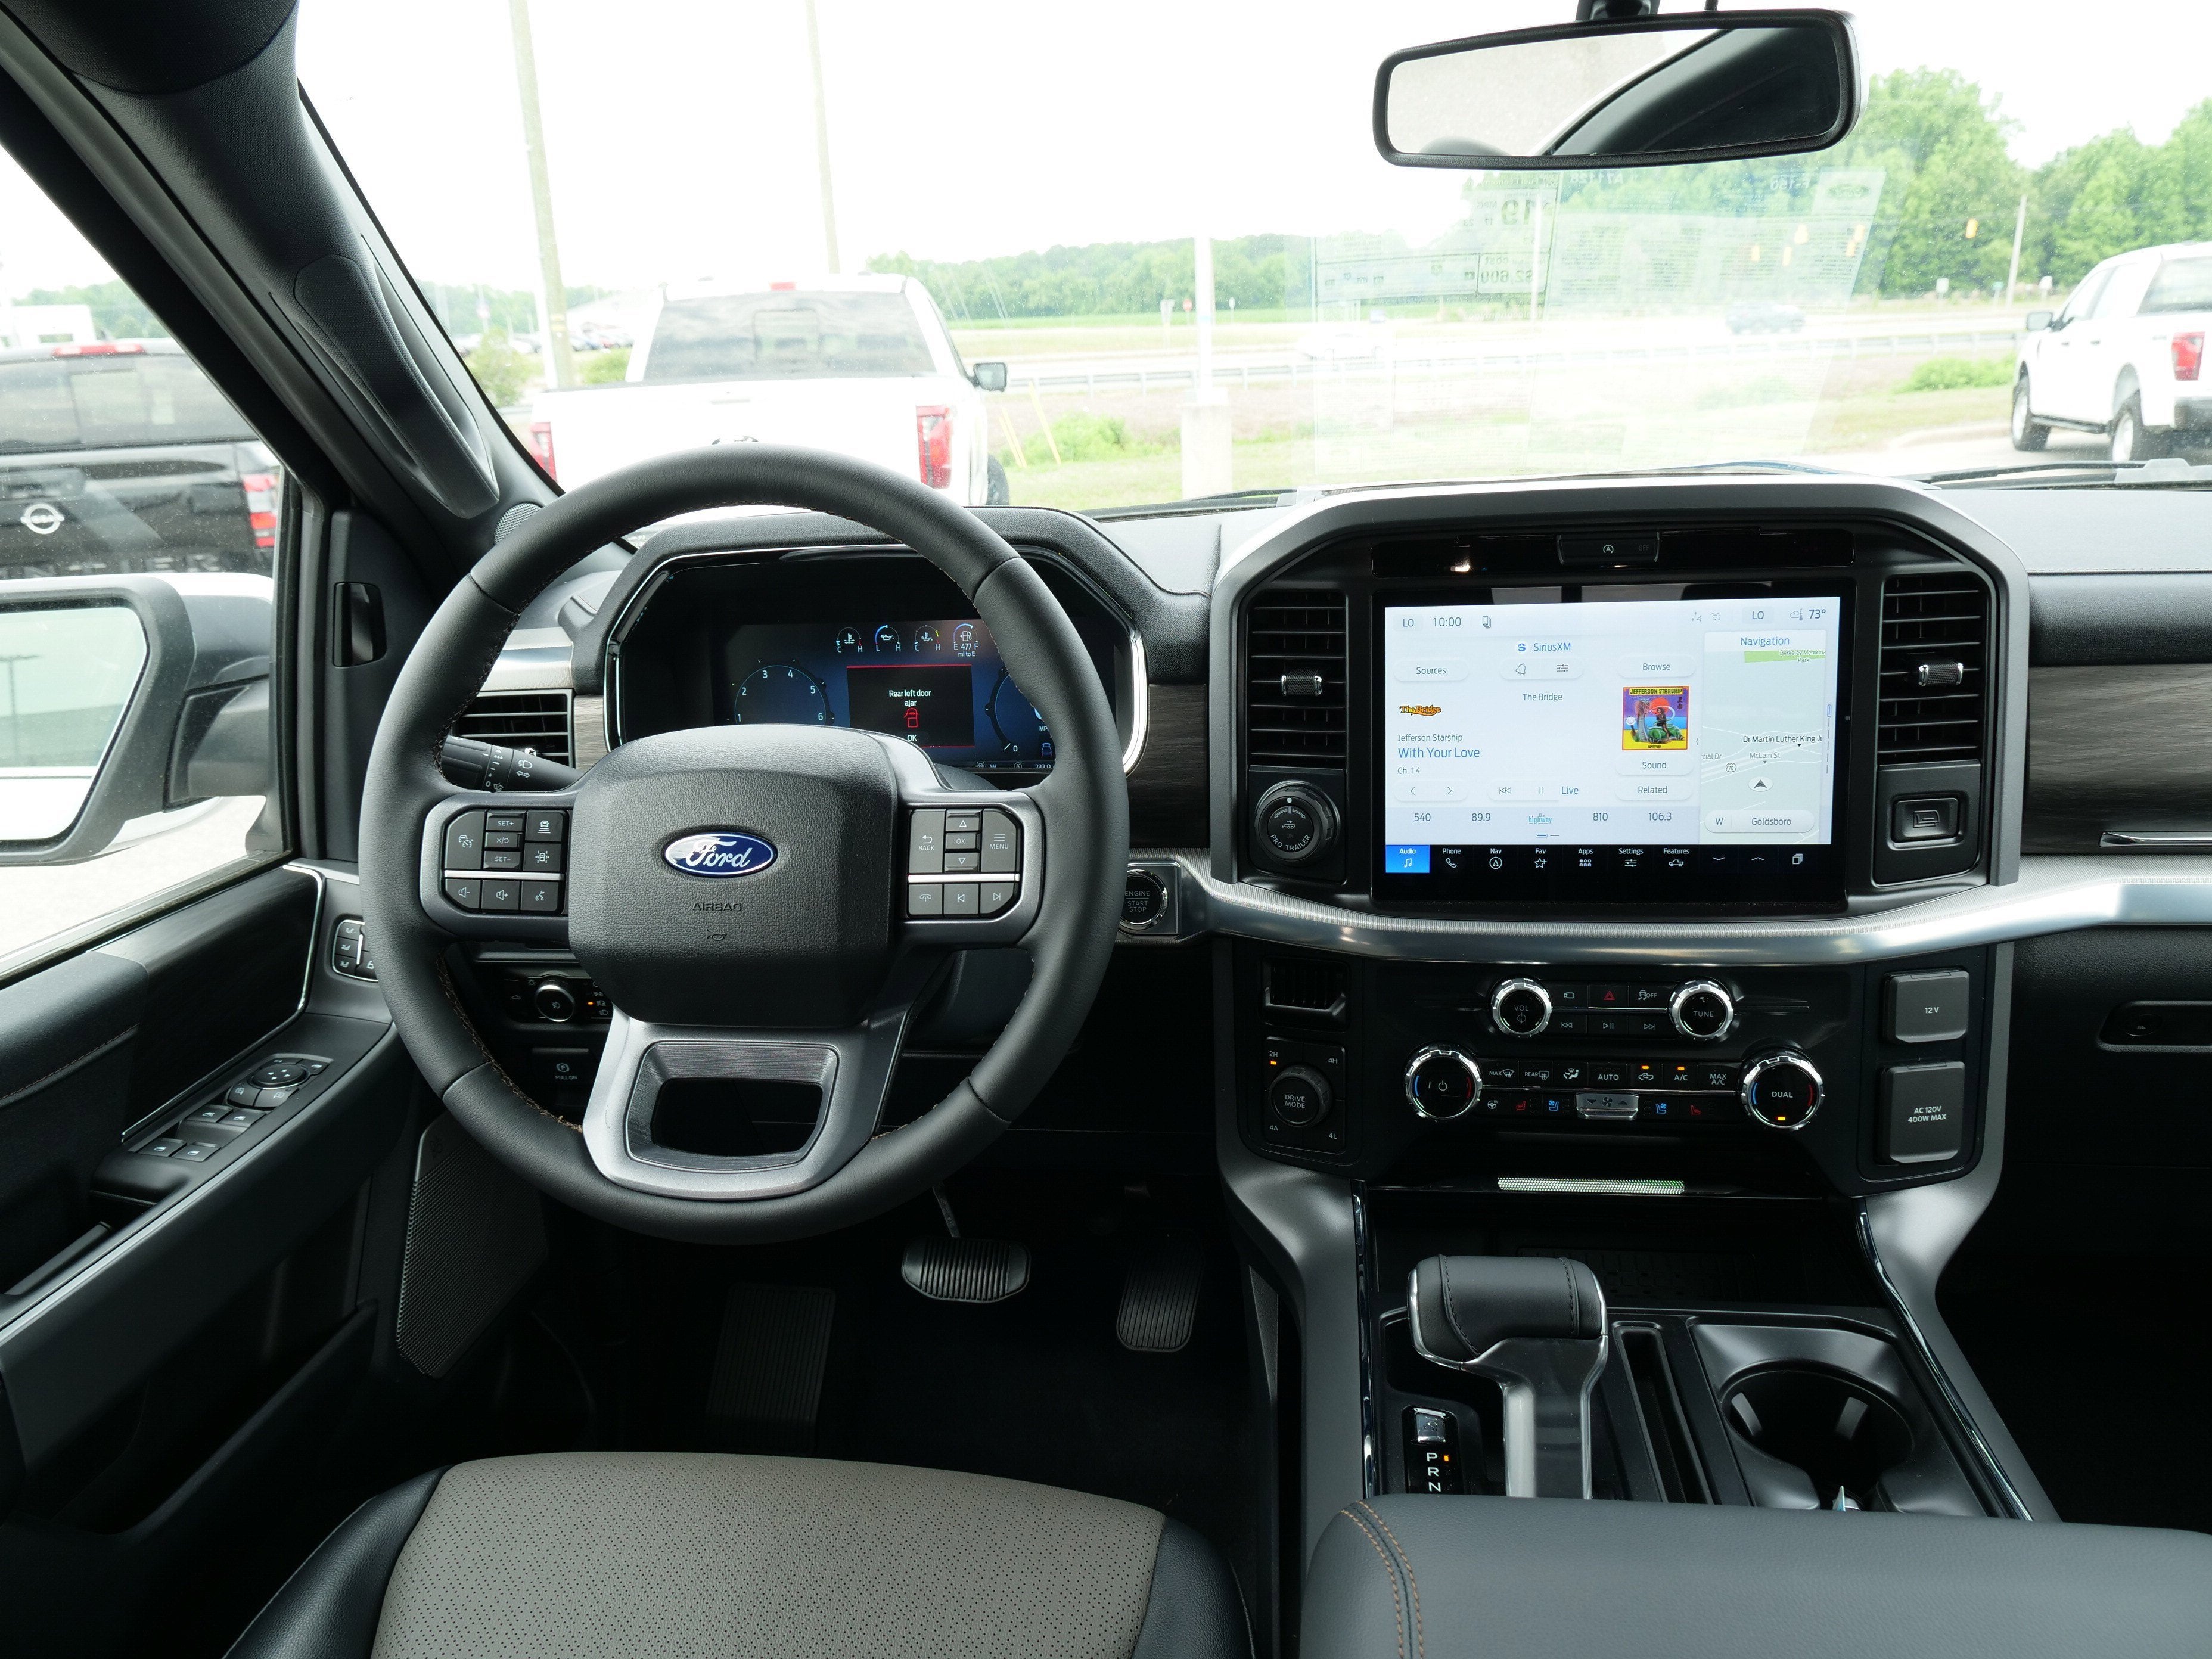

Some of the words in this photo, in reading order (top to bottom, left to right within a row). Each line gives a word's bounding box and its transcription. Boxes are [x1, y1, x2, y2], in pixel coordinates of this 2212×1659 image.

[1752, 611, 1764, 620] LO
[1809, 609, 1826, 619] 73°
[1403, 619, 1414, 627] LO
[1433, 617, 1461, 627] 10:00
[1740, 637, 1790, 647] Navigation
[1533, 642, 1571, 652] SiriusXM
[1416, 666, 1446, 675] Sources
[742, 687, 747, 695] 2
[1538, 693, 1562, 703] Bridge
[1415, 704, 1441, 715] Bridge
[818, 713, 823, 721] 6
[1433, 734, 1463, 742] Starship
[1399, 747, 1424, 758] With
[1427, 748, 1452, 758] Your
[1455, 747, 1480, 758] Love
[1642, 761, 1667, 769] Sound
[1561, 787, 1579, 795] Live
[1414, 813, 1431, 822] 540
[1471, 813, 1490, 822] 89.9
[1529, 816, 1552, 824] highway
[1593, 813, 1608, 822] 810
[1648, 812, 1672, 821] 106.3
[1270, 834, 1283, 847] PRO
[1285, 835, 1311, 851] TRAILER
[686, 838, 753, 868] Ford
[692, 902, 742, 912] AIRBAG
[1285, 1094, 1305, 1102] DRIVE
[1427, 1452, 1438, 1462] P
[1428, 1467, 1439, 1477] R
[1428, 1481, 1441, 1492] N
